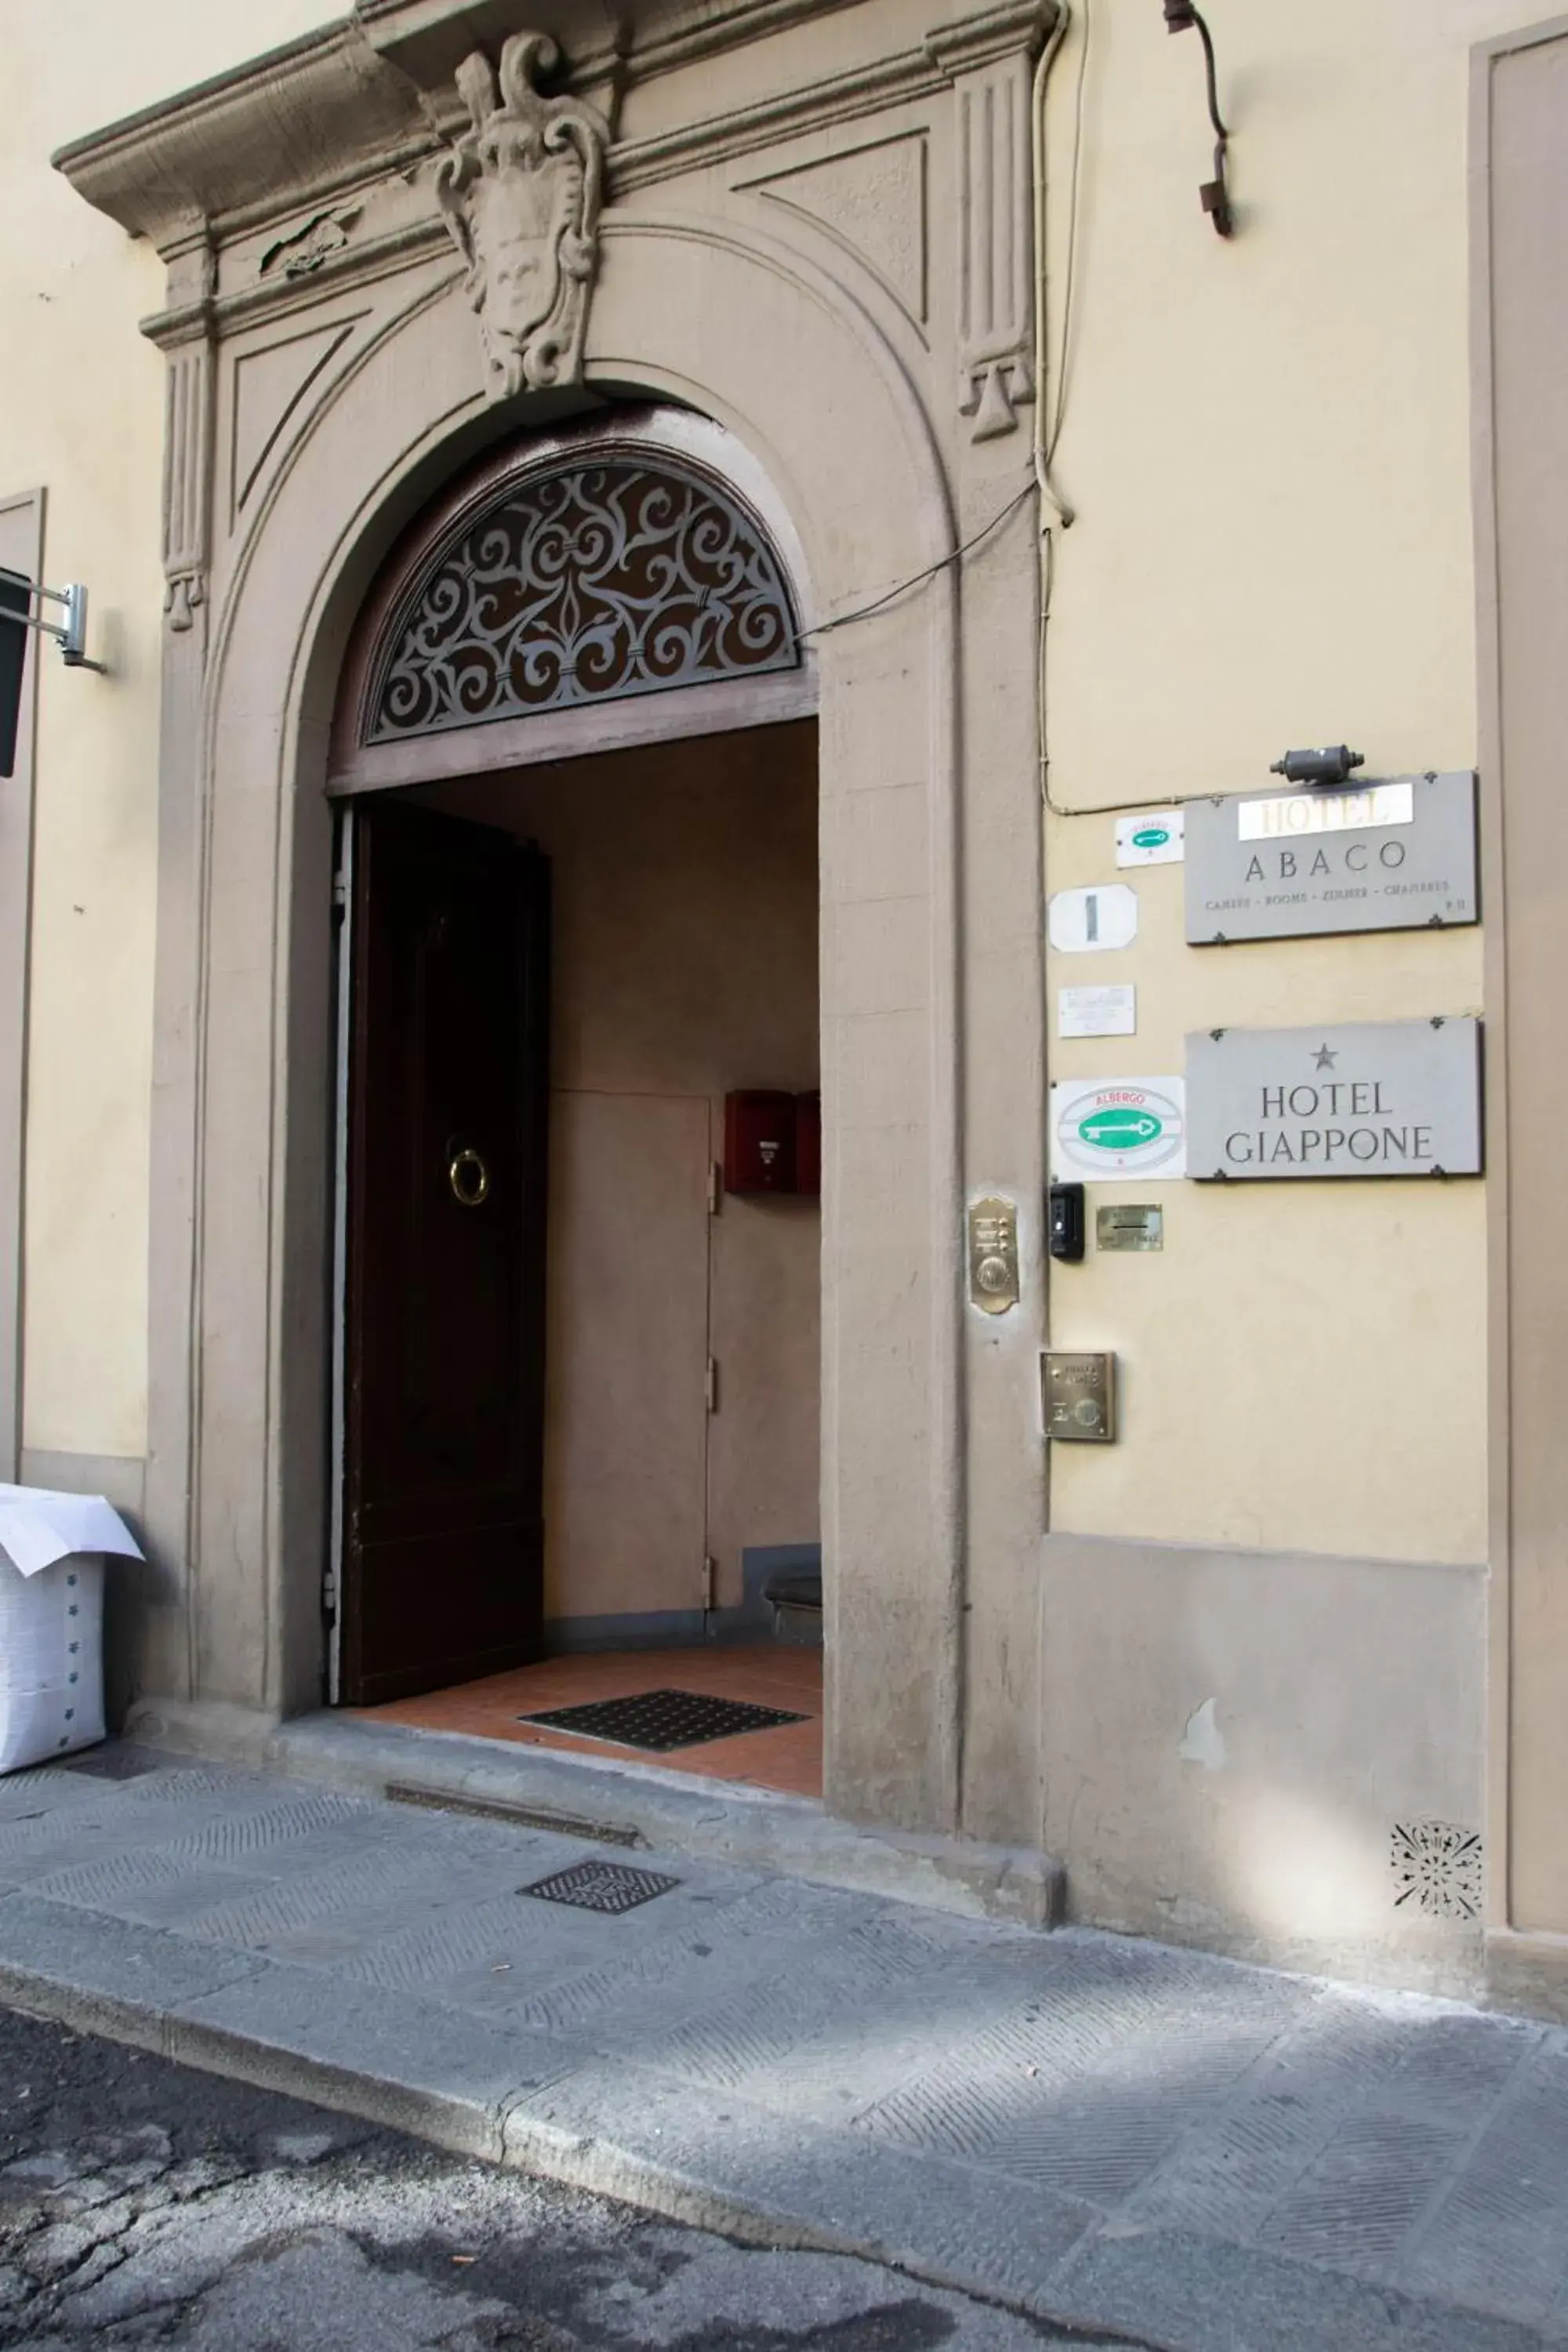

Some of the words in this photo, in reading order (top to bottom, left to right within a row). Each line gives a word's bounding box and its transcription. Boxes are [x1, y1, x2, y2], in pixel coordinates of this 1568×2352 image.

[1261, 789, 1388, 833] HOTEL
[1245, 840, 1406, 882] ABACO
[1265, 892, 1307, 906] ROOMS
[1095, 1091, 1146, 1105] ALBERGO
[1261, 1082, 1392, 1118] HOTEL
[1225, 1126, 1433, 1163] GIAPPONE
